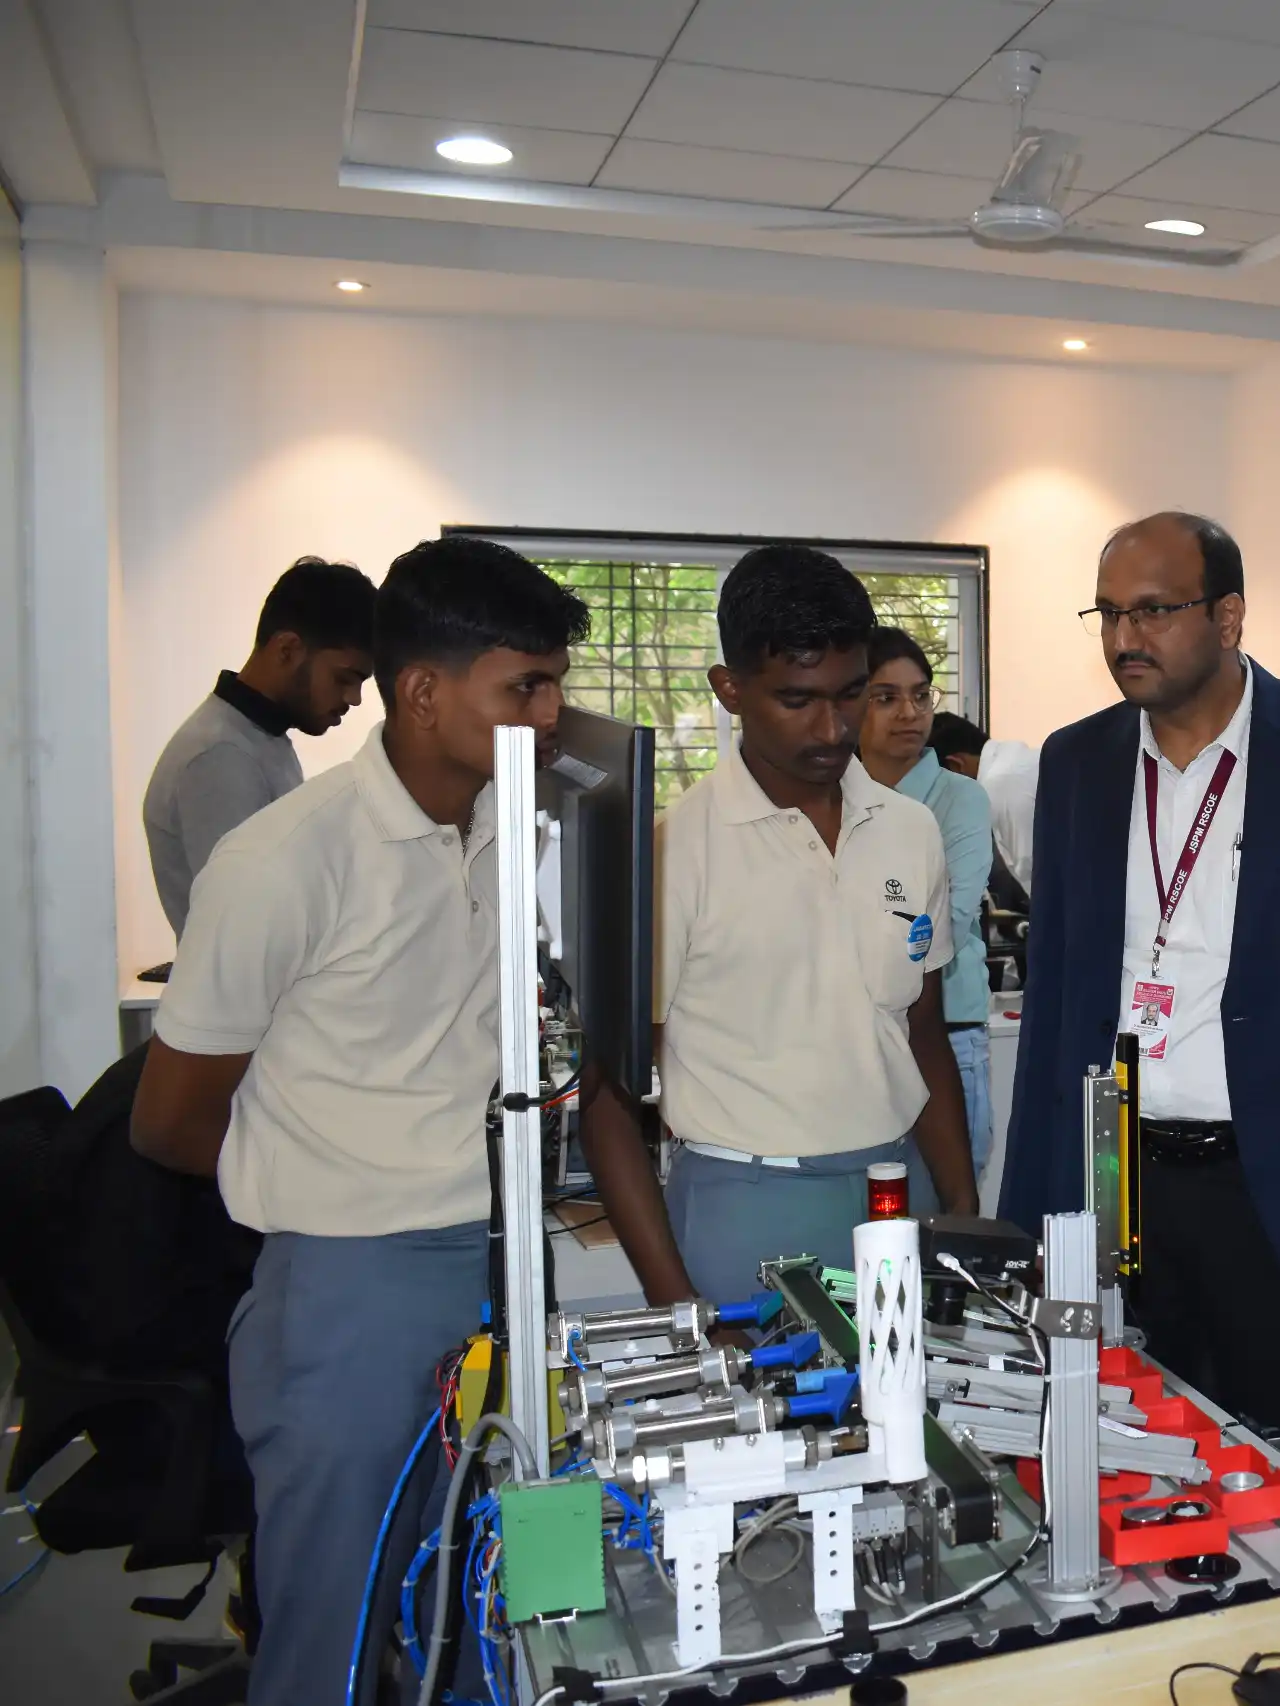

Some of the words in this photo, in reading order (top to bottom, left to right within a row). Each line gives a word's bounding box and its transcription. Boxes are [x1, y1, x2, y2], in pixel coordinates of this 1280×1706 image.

[1189, 827, 1205, 854] JSPM
[1198, 793, 1218, 826] RSCOE
[1169, 869, 1188, 904] RSCOE
